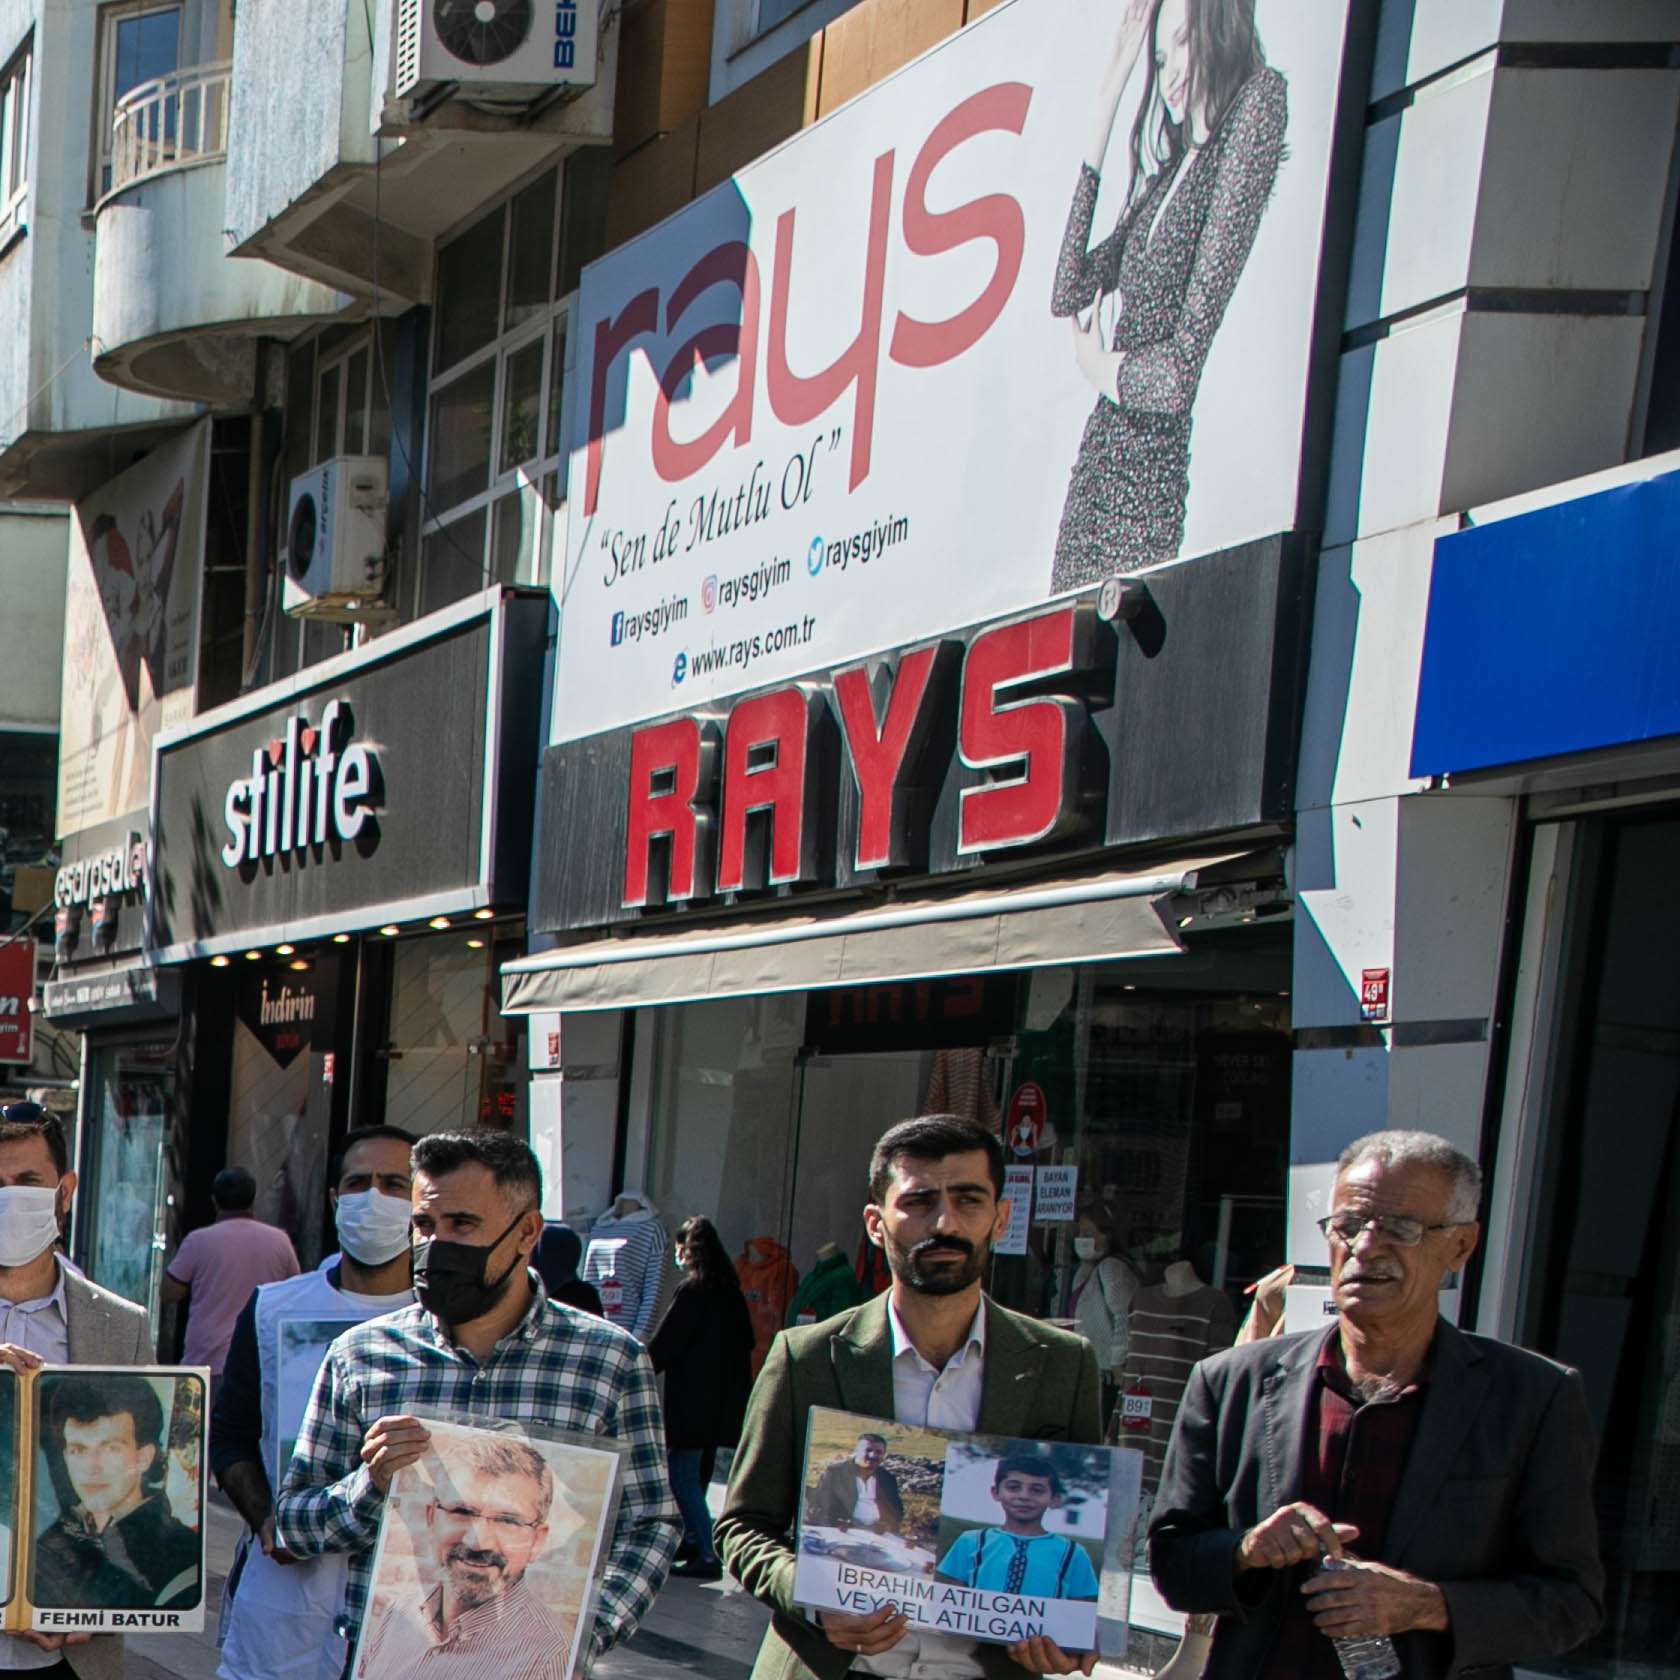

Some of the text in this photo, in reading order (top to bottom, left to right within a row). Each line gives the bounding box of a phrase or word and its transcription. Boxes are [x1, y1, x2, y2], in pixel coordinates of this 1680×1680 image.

[583, 81, 1033, 516] rays
[652, 499, 681, 564] de
[685, 460, 772, 553] Mutlu
[826, 515, 909, 570] raysgiyim
[719, 557, 791, 608] raysgiyim
[625, 596, 689, 641] raysgiyim
[691, 614, 816, 678] www.rays.com.tr
[621, 600, 1078, 909] RAYS
[221, 700, 371, 869] stilife
[1040, 1186, 1071, 1200] ELEMAN
[1043, 1170, 1069, 1184] BAYAN
[1037, 1202, 1074, 1214] ARANIYOR
[1127, 1398, 1144, 1414] 89
[837, 1563, 1046, 1618] İBRAHİM ATILGAN
[39, 1609, 181, 1628] FEHMİ BATUR
[935, 1608, 1044, 1638] ATILGAN
